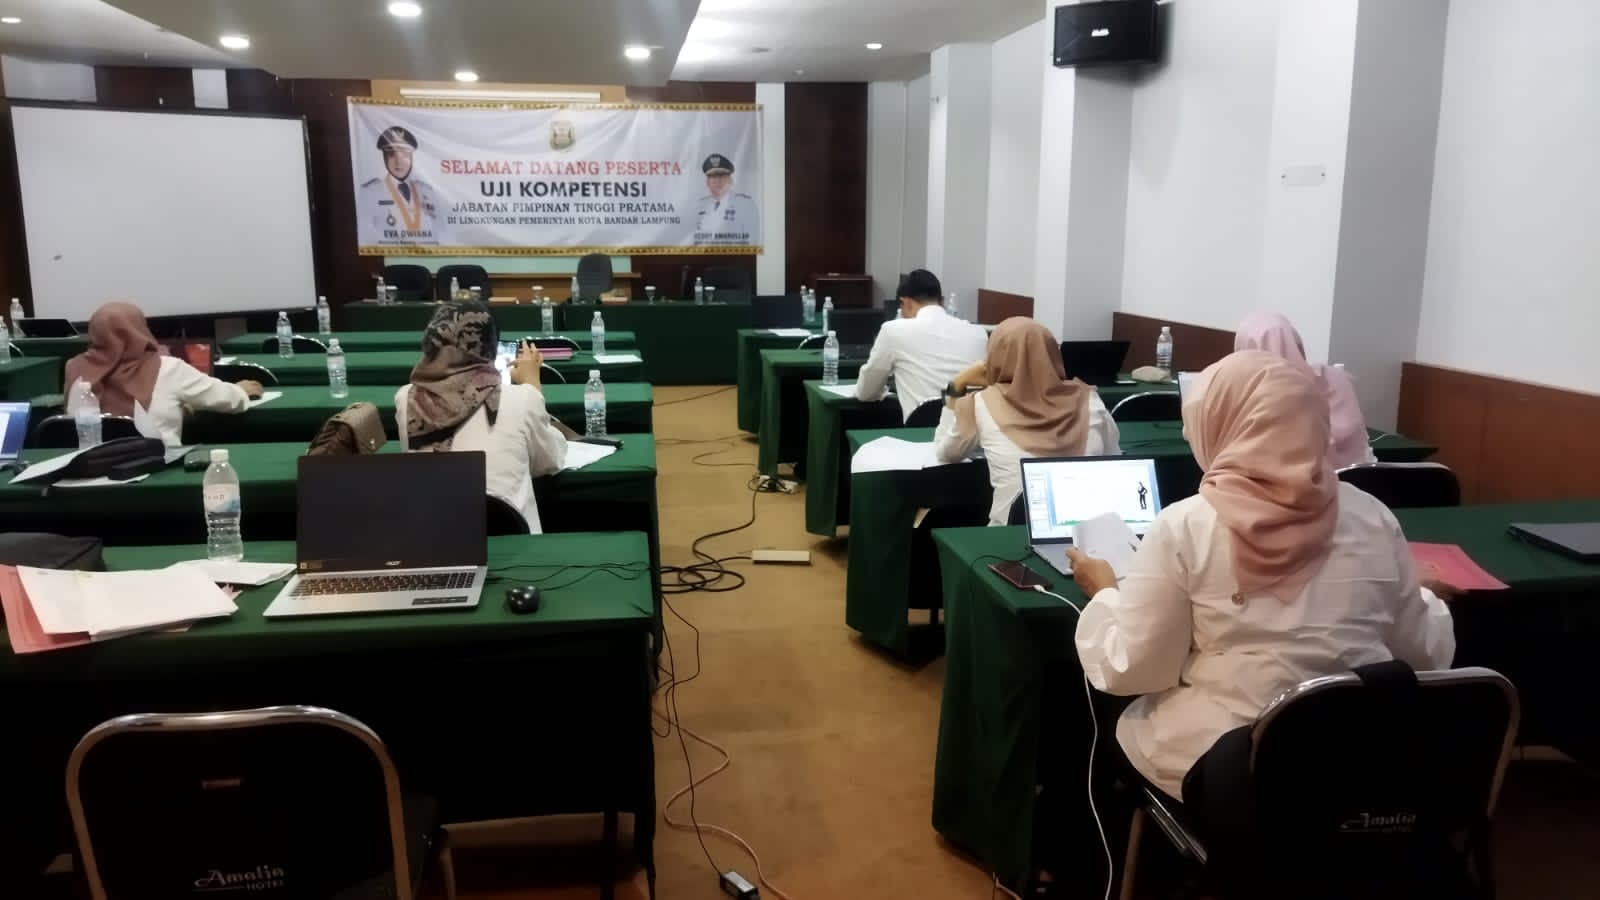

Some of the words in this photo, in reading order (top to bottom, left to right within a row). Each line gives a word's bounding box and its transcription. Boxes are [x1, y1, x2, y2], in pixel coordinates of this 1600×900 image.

[440, 159, 522, 175] SELAMAT
[530, 160, 600, 175] DATANG
[605, 160, 682, 175] PESERTA
[480, 181, 512, 197] UJI
[519, 181, 648, 198] KOMPETENSI
[451, 202, 509, 213] JABATAN
[512, 202, 570, 213] PIMPINAN
[574, 202, 615, 213] TINGGI
[619, 202, 676, 213] PRATAMA
[447, 215, 457, 225] DI
[459, 215, 517, 225] LINGKUNGAN
[519, 215, 576, 225] PEMERINTAH
[578, 215, 602, 225] KOTA
[641, 215, 681, 225] LAMPUNG
[383, 229, 399, 239] EVA
[194, 865, 285, 887] Amalia
